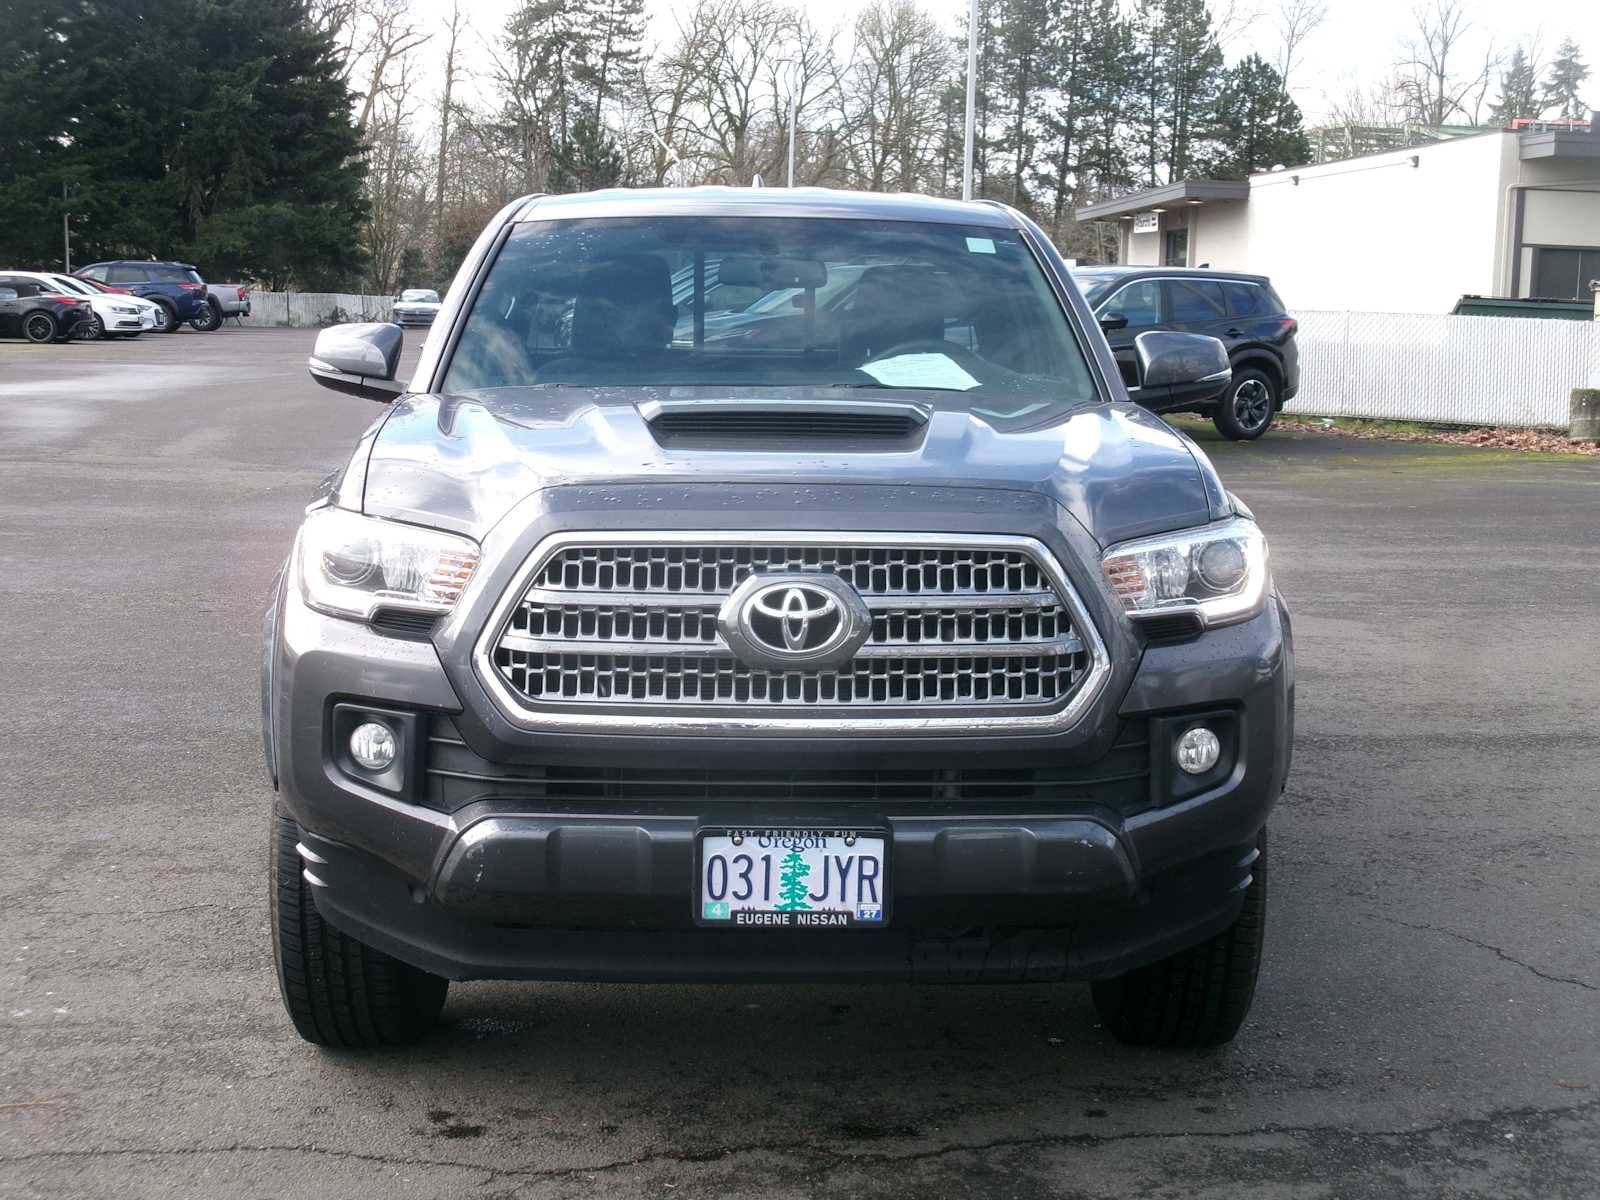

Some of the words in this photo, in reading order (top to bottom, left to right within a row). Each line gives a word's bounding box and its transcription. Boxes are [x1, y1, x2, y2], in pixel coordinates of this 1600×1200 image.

[758, 837, 827, 852] Oregon
[707, 854, 772, 901] 031
[809, 855, 879, 903] JYR
[711, 903, 721, 915] 4
[737, 913, 790, 925] EUGENE
[797, 914, 847, 926] NISSAN
